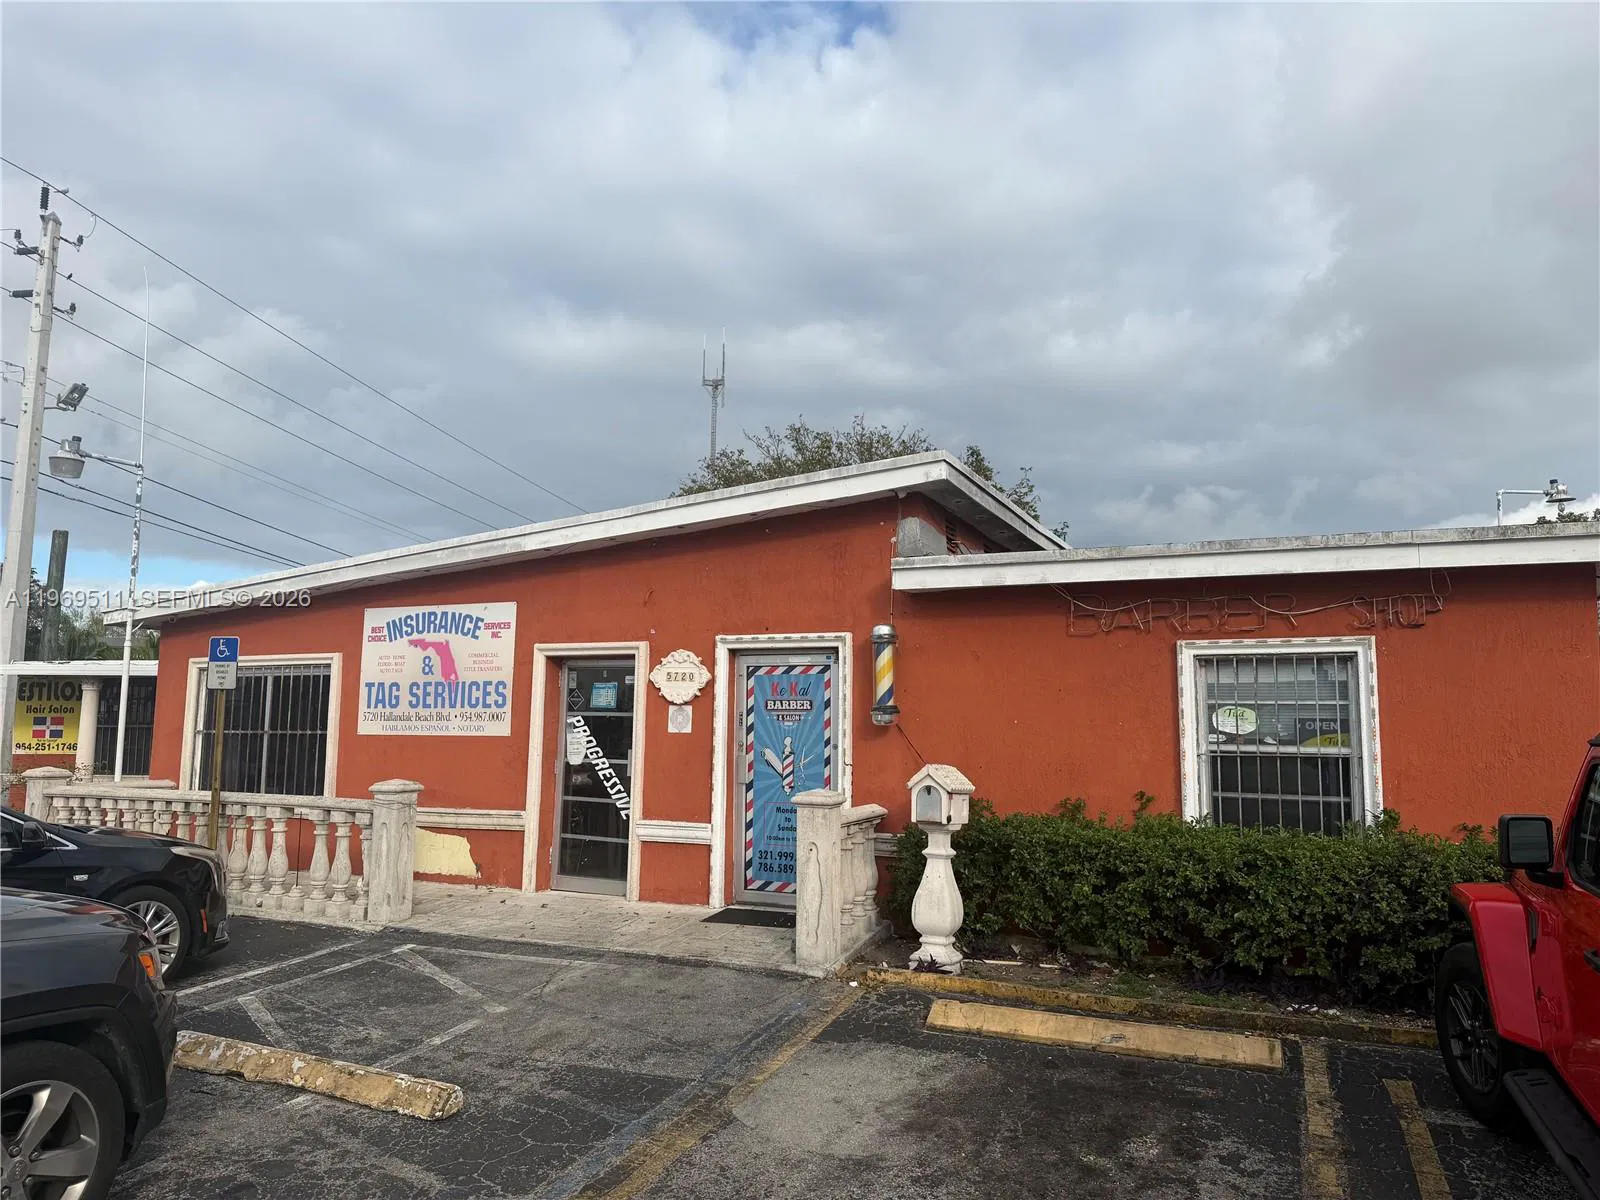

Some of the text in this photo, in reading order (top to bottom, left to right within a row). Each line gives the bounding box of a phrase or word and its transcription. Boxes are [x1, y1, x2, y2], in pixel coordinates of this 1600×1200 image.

[1067, 593, 1443, 635] BARBER SHOP
[370, 626, 385, 634] BEST
[386, 611, 485, 642] INSURANCE
[483, 622, 511, 630] SERVICES
[421, 655, 435, 676] &
[666, 671, 695, 681] 5720
[365, 680, 507, 709] TAG SERVICES
[25, 704, 75, 714] Hair Salon
[766, 700, 812, 710] BARBER
[362, 711, 379, 722] 5720
[380, 711, 414, 722] Hallandale
[414, 711, 435, 722] Beach
[459, 711, 507, 722] 954.987.0007
[457, 724, 485, 732] NOTARY
[1305, 721, 1339, 730] OPEN
[567, 715, 631, 820] PROGRESSIVE
[775, 806, 797, 814] Monda
[777, 824, 797, 832] Sunda
[758, 850, 797, 862] 321.999.
[758, 862, 797, 875] 786.589.
